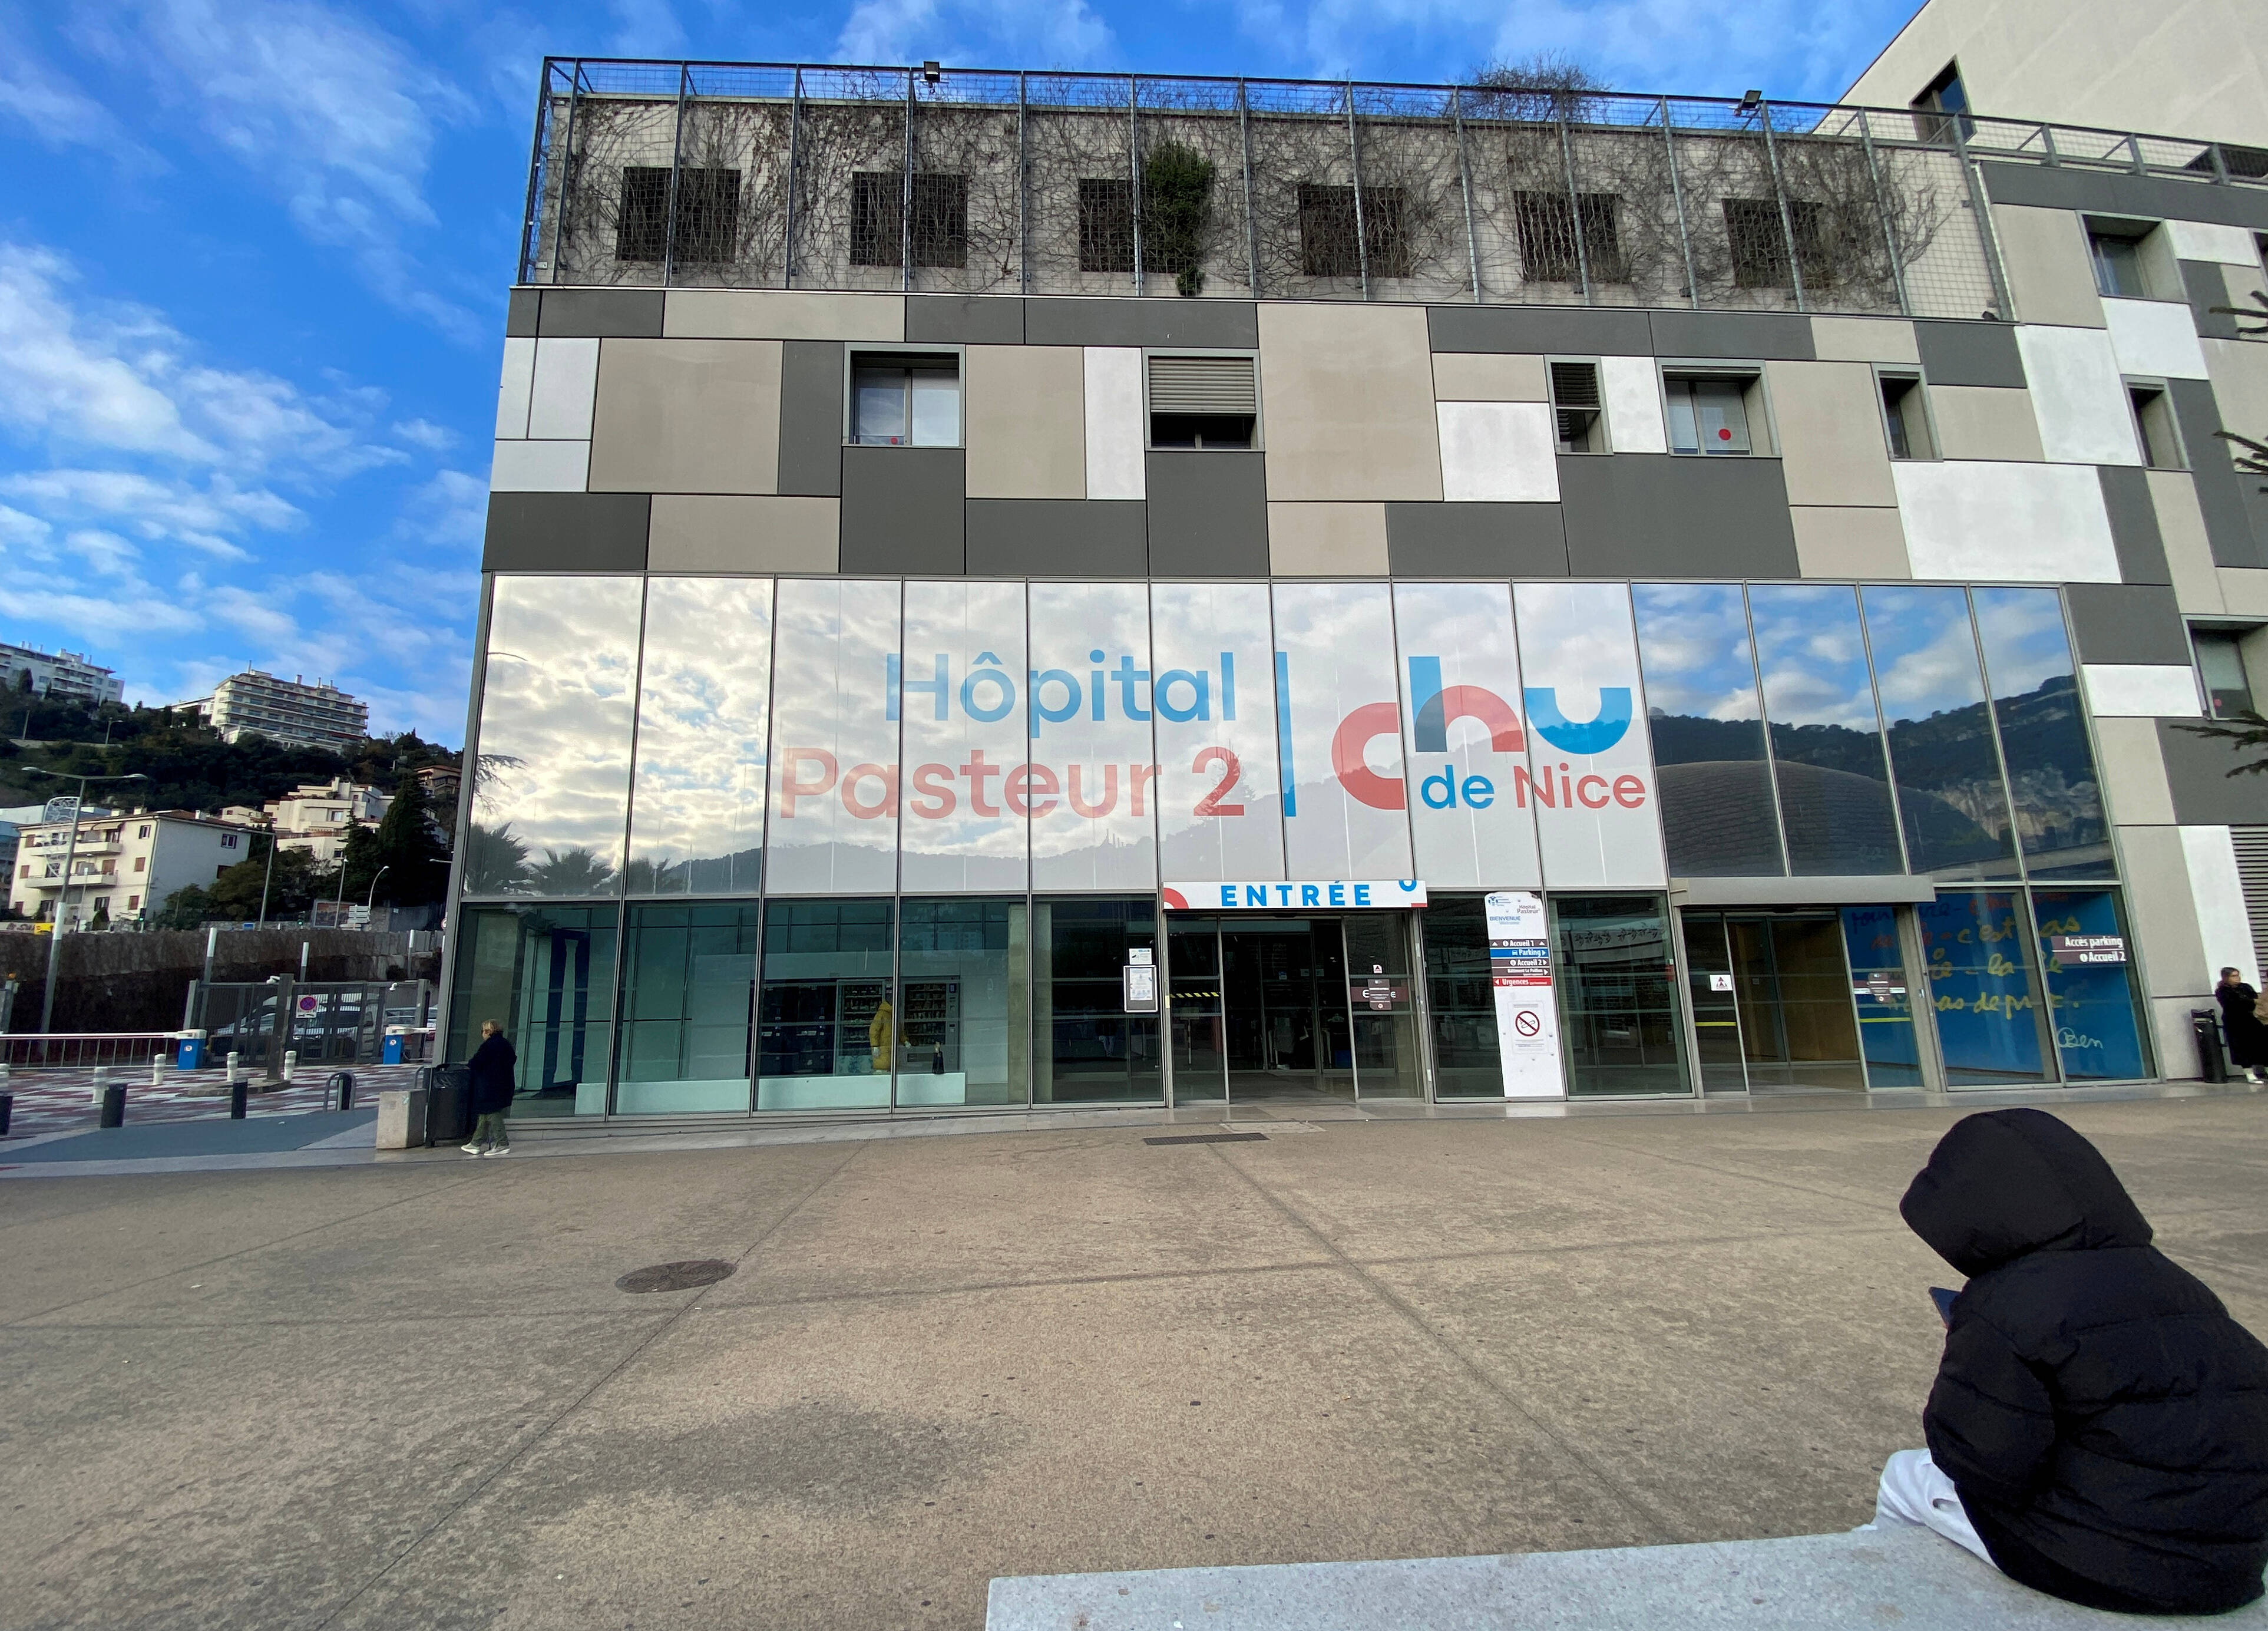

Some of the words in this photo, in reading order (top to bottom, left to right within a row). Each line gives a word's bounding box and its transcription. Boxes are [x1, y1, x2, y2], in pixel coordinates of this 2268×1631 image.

[885, 649, 1236, 738] Hôpital
[1331, 656, 1632, 810] chu
[780, 747, 1162, 820] Pasteur
[1191, 746, 1245, 817] 2
[1420, 764, 1495, 810] de
[1513, 762, 1646, 809] Nice
[1221, 880, 1371, 906] ENTRÉE
[1518, 949, 1541, 958] Parking
[2065, 936, 2088, 947] Accès
[2089, 935, 2123, 949] parking
[2088, 951, 2119, 962] Accueil
[2119, 951, 2127, 962] 2
[1502, 978, 1529, 987] Urgences
